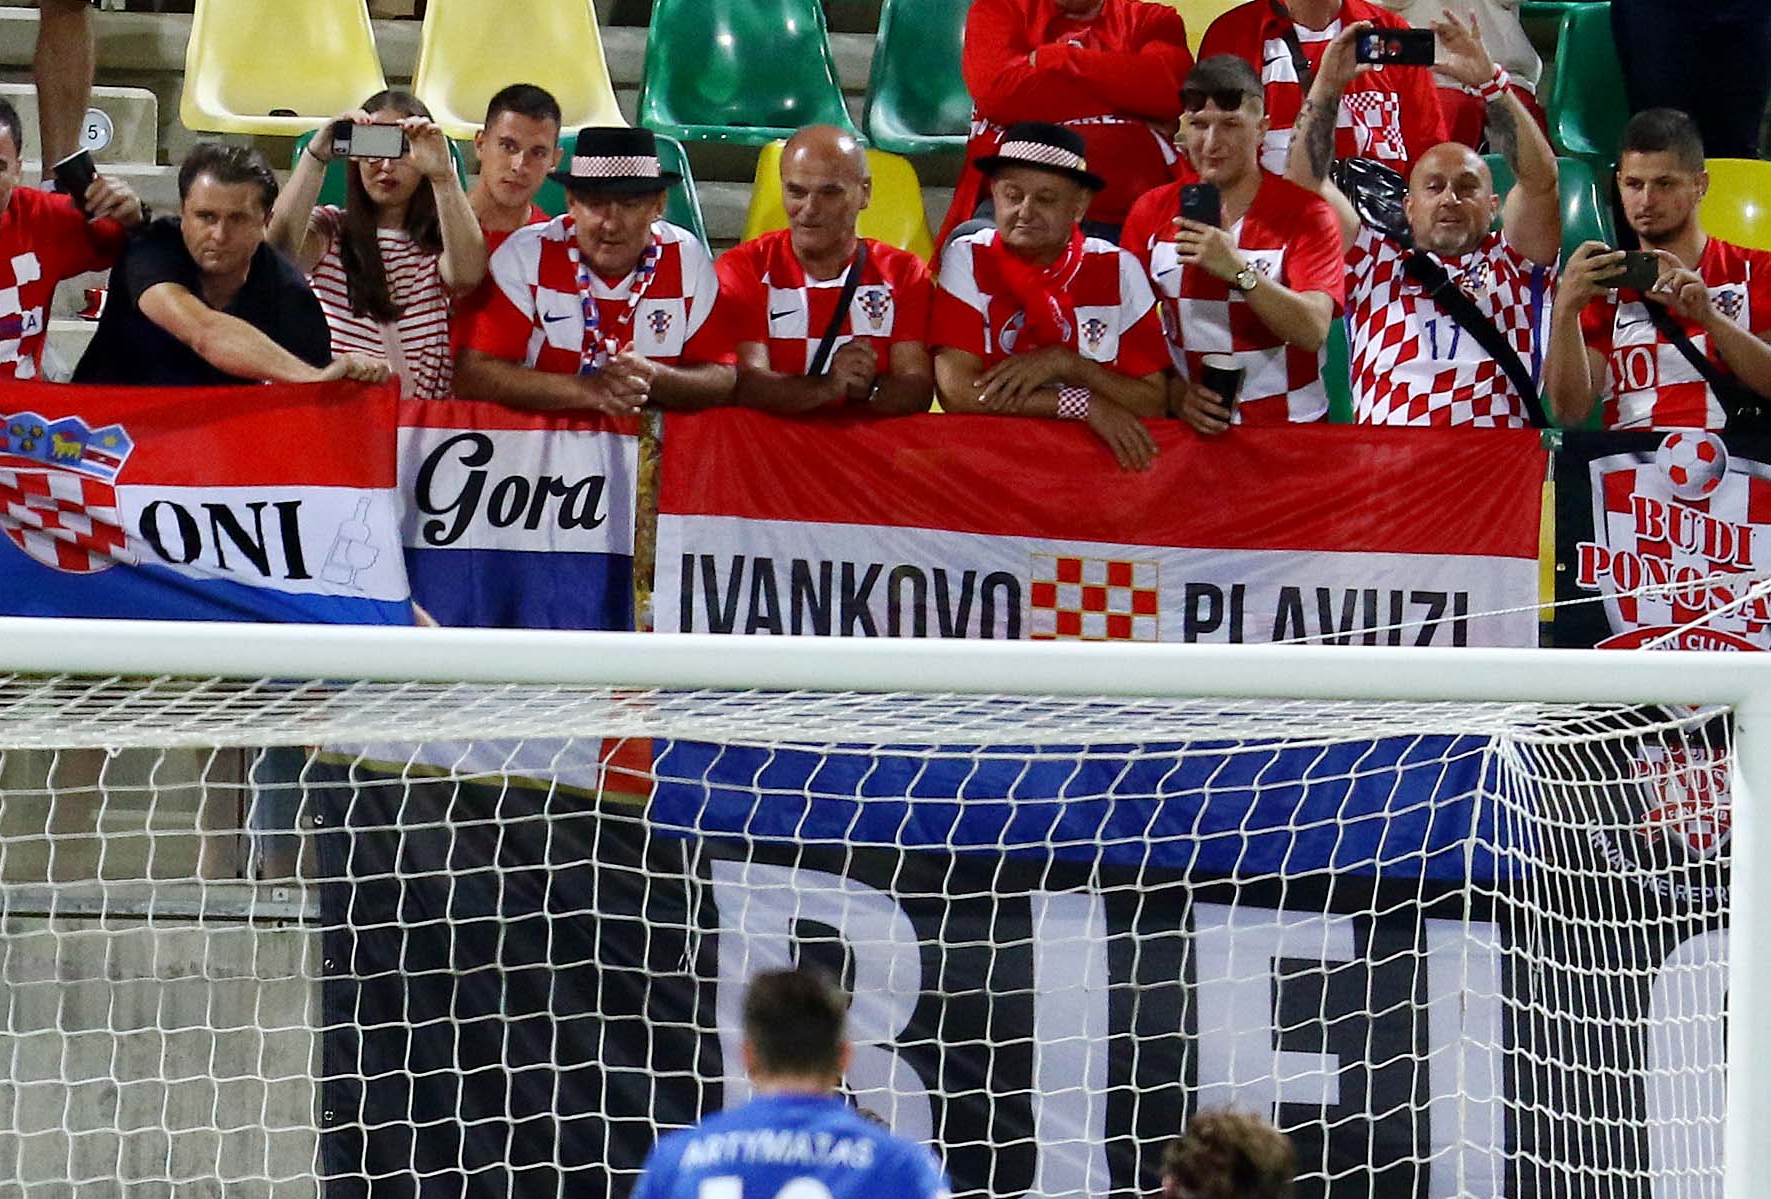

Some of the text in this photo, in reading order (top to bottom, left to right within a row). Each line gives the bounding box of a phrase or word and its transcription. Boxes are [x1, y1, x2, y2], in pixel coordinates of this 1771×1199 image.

[88, 124, 98, 140] 5
[1612, 346, 1656, 391] 10
[415, 432, 607, 546] Gora
[1629, 494, 1754, 566] BUDI
[679, 552, 1022, 640] IVANKOVO
